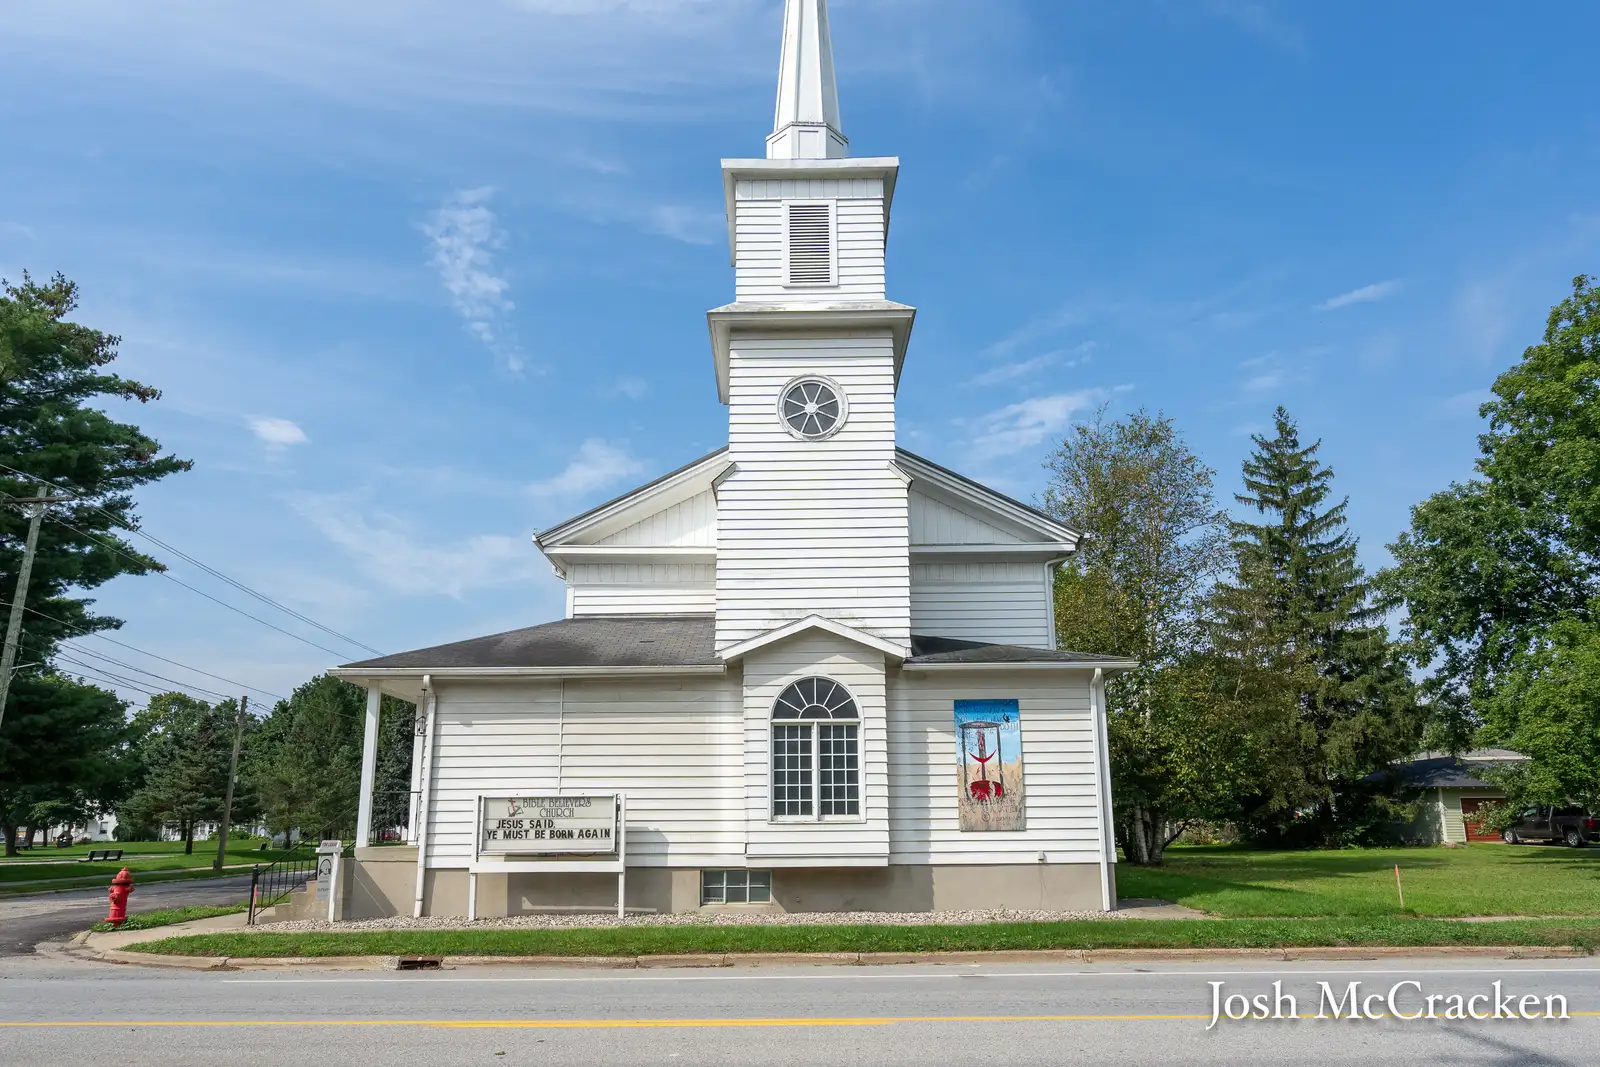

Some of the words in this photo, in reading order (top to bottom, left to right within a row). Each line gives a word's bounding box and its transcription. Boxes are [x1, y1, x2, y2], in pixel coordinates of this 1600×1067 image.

[522, 797, 545, 808] BIBLE
[548, 797, 592, 808] BELIEVERS
[539, 808, 575, 818] CHURCH
[496, 820, 523, 830] JESUS
[487, 830, 498, 840] YE
[503, 829, 530, 840] MUST
[534, 829, 546, 839] BE
[550, 829, 574, 839] BORN
[578, 828, 611, 839] AGAIN
